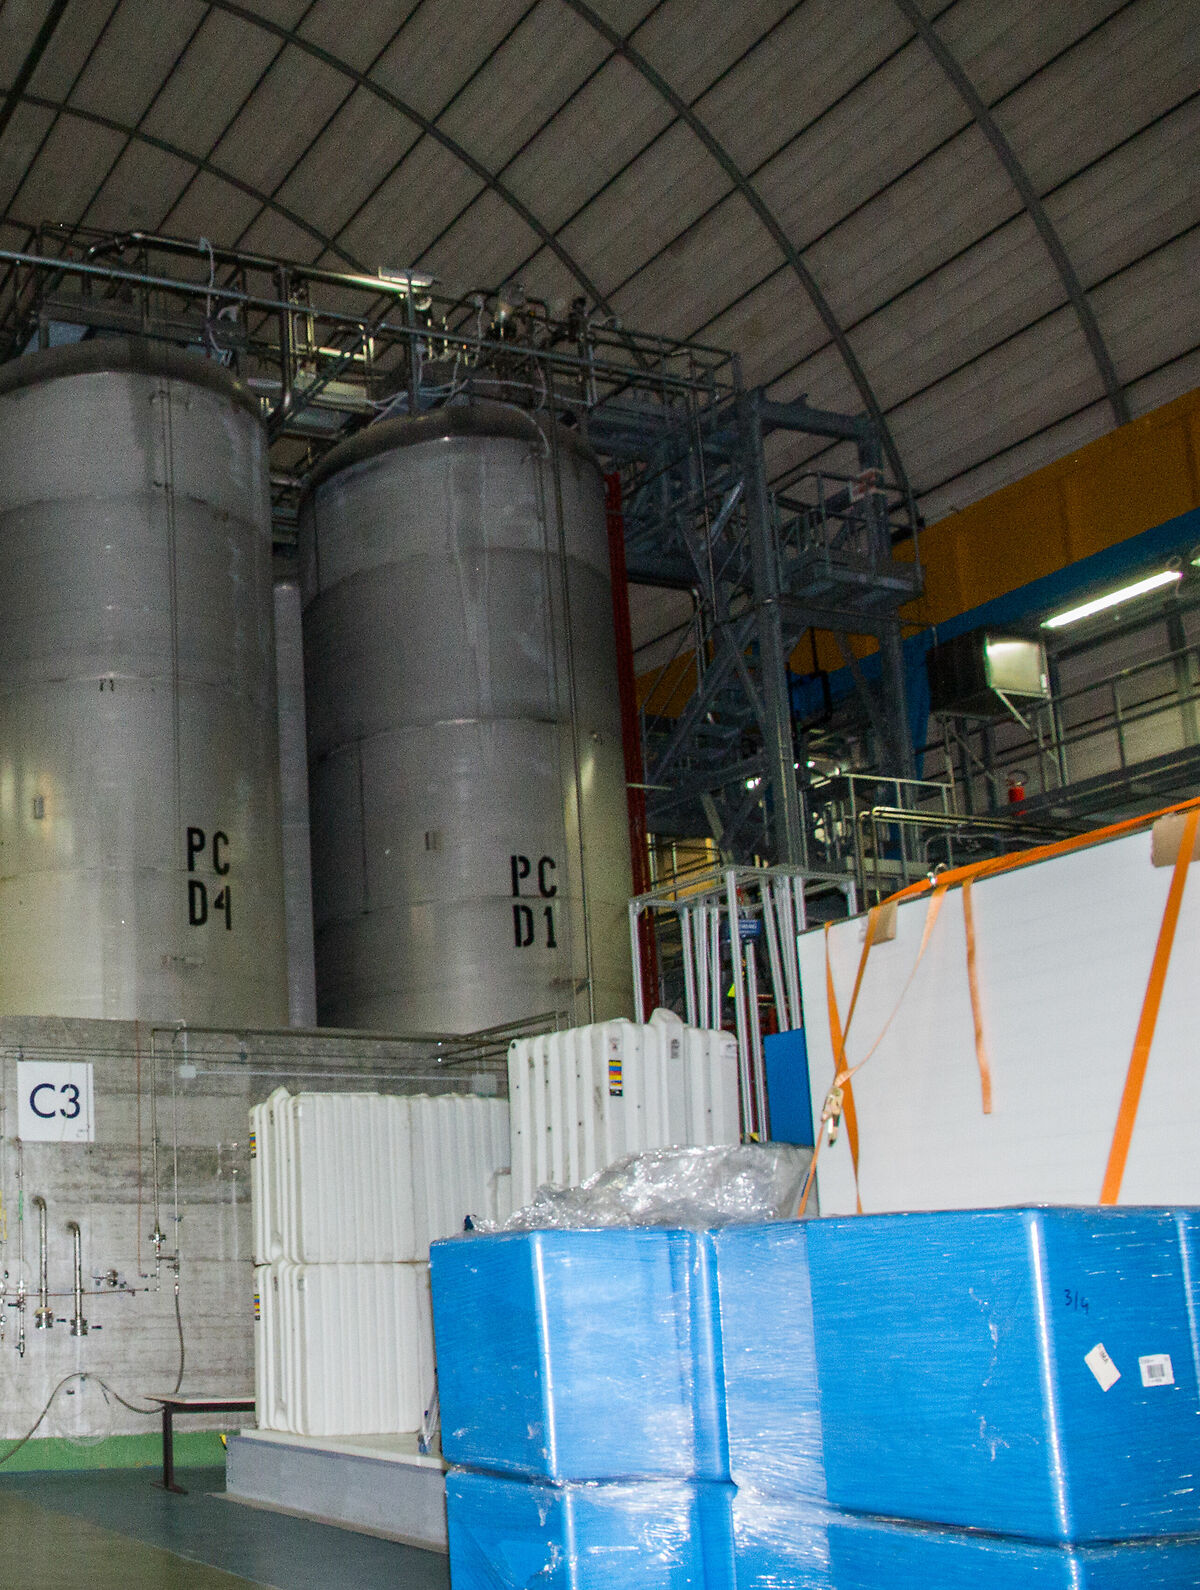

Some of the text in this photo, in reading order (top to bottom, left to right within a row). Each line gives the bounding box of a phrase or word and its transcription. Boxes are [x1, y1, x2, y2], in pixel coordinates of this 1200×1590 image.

[187, 827, 230, 875] PC
[511, 855, 557, 898] PC
[188, 880, 231, 931] D4
[513, 904, 557, 948] D1
[29, 1083, 81, 1119] C3
